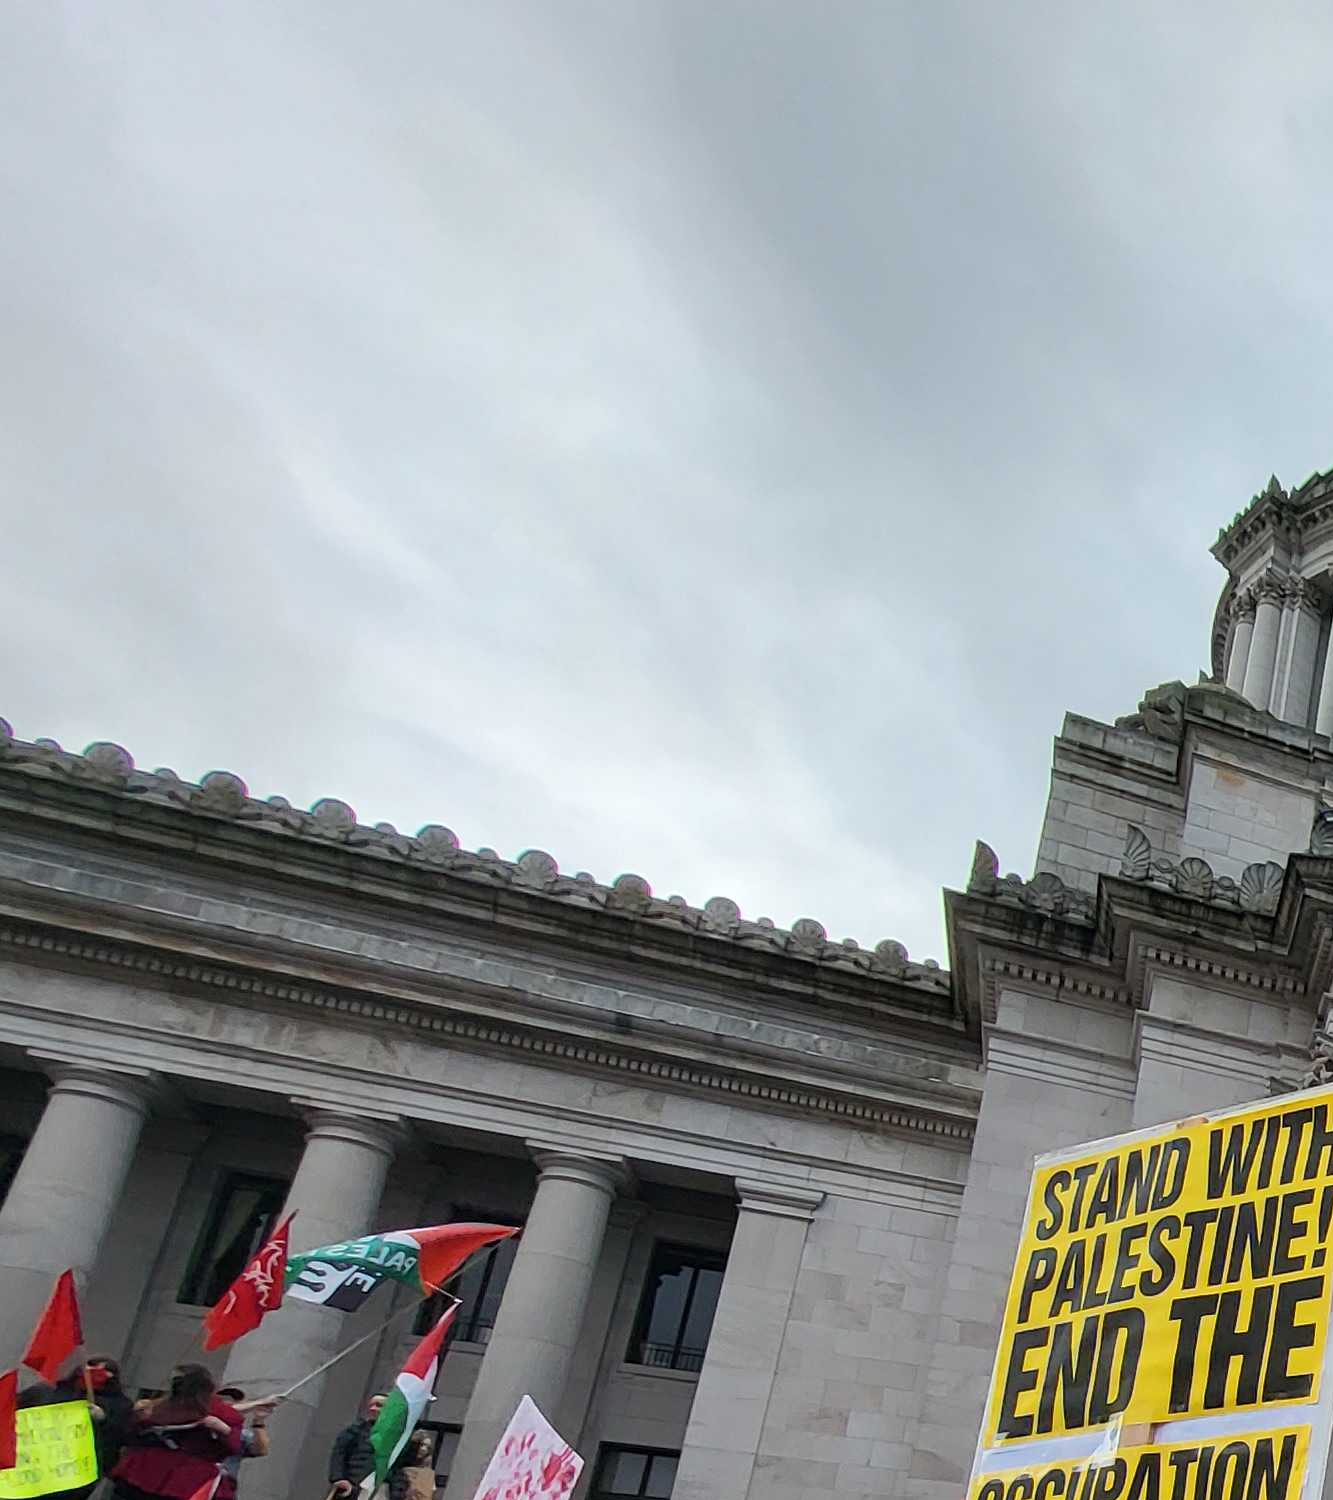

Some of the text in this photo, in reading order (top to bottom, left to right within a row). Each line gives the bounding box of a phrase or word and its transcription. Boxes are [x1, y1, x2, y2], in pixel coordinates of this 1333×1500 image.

[1036, 1138, 1190, 1240] STAND
[998, 1276, 1324, 1438] END THE
